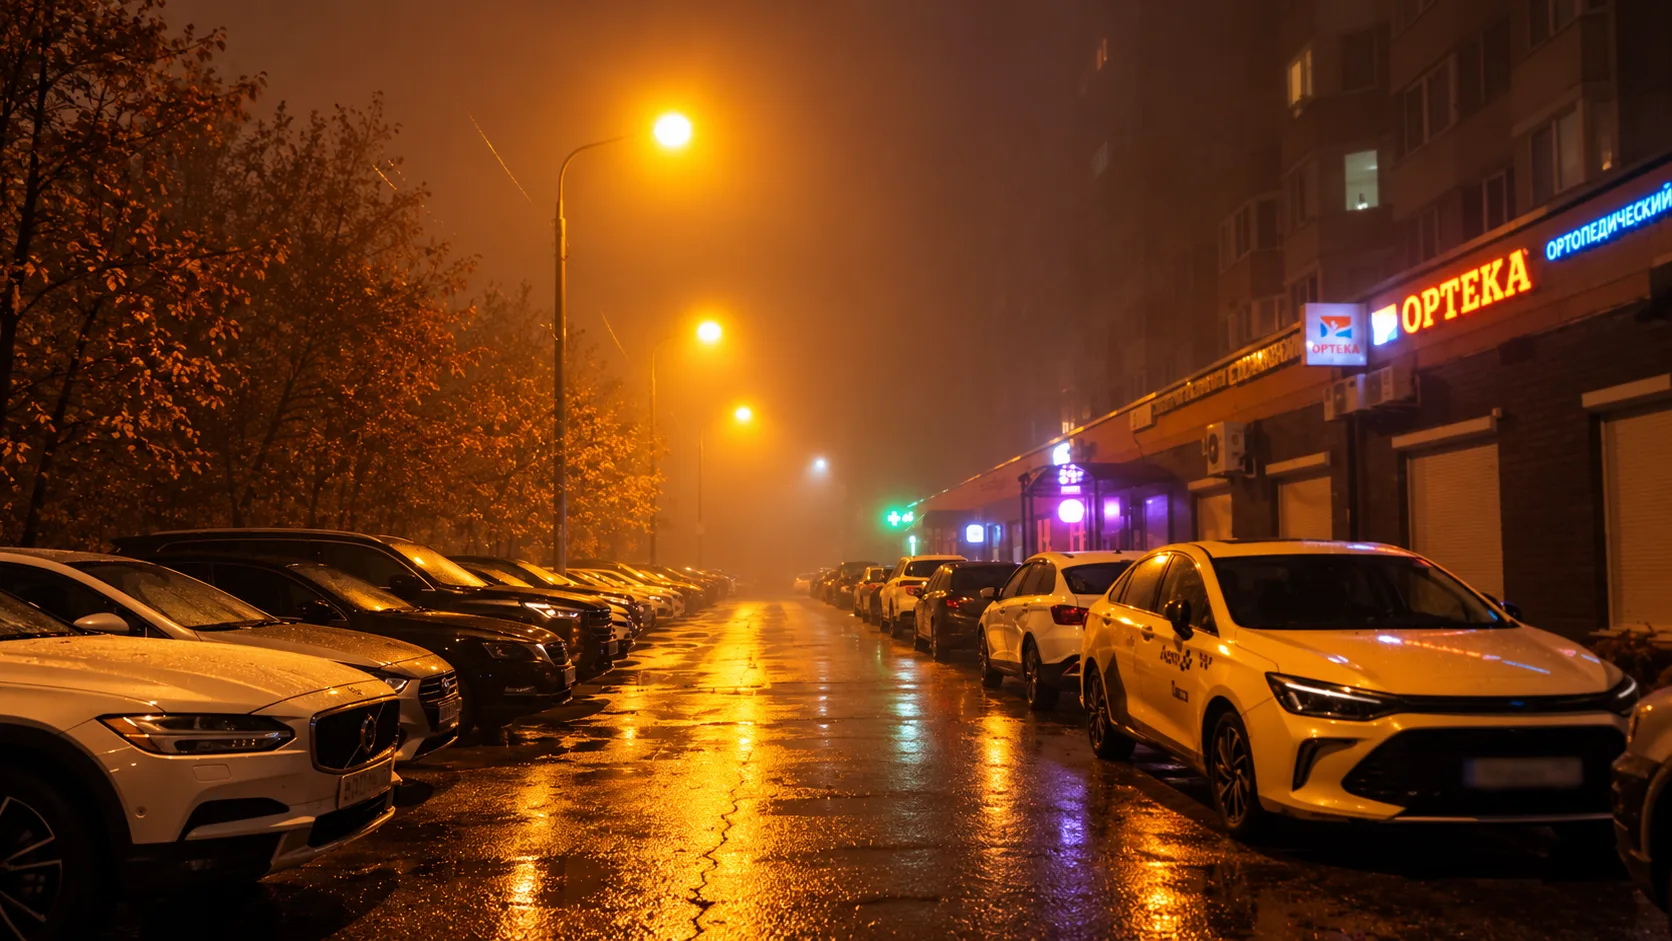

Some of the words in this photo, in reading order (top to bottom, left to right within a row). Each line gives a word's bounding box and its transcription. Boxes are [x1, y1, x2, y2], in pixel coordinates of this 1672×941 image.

[1546, 182, 1672, 260] ОРТОПЕДИЧЕСКИЙ
[1402, 249, 1531, 334] ОРТЕКА
[1312, 343, 1360, 354] ОРТЕКА
